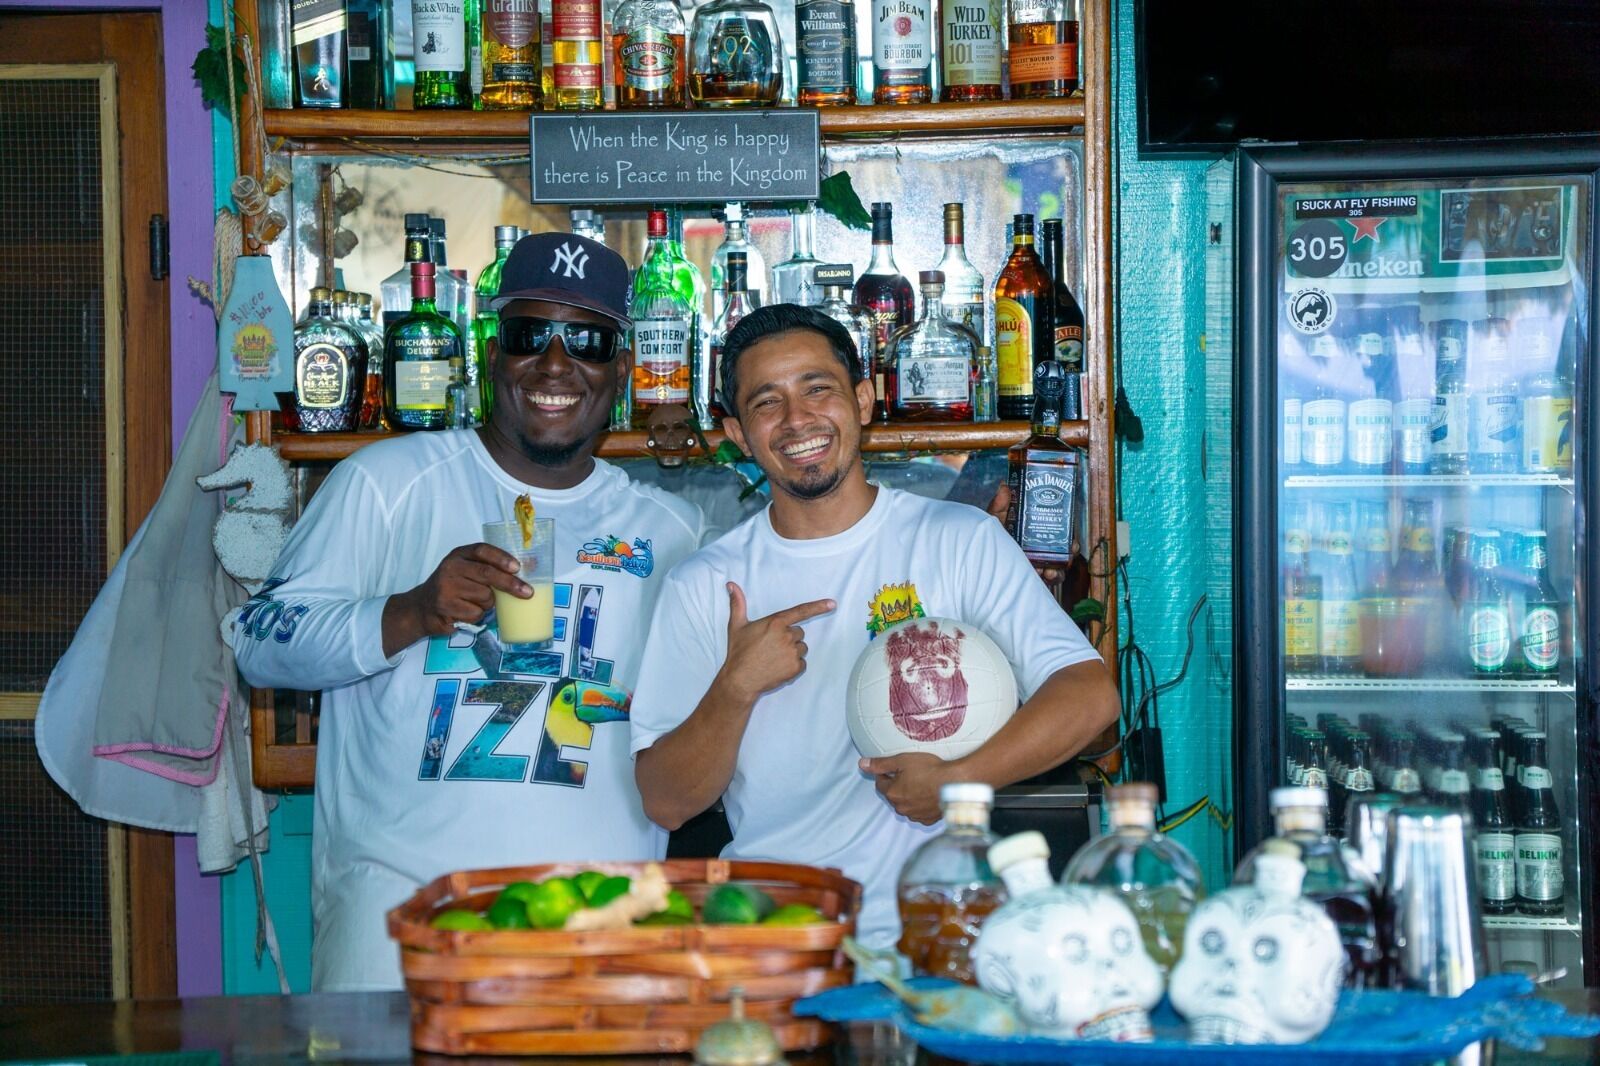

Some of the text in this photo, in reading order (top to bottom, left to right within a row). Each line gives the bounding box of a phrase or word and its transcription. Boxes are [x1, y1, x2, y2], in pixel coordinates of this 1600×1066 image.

[809, 10, 837, 20] Evan
[880, 1, 924, 22] JIM BEAM
[954, 6, 985, 23] WILD
[947, 23, 991, 40] TURKEY
[622, 44, 673, 56] CHIVAS REGAL
[884, 49, 922, 59] BOURBON
[949, 43, 974, 65] 101
[569, 121, 790, 156] When the King is happy
[544, 157, 808, 189] there is Peace in the Kingdom
[1296, 197, 1417, 211] I SUCK AT FLY FISHING
[1290, 236, 1345, 262] 305
[550, 241, 590, 280] NY
[1328, 256, 1425, 278] ineken
[1291, 287, 1326, 302] POLAR
[997, 318, 1025, 333] HLÚA
[1296, 317, 1332, 332] CAMEL
[638, 329, 685, 342] SOUTHERN
[1055, 327, 1082, 340] AILE
[395, 338, 450, 347] BUCHANAN'S
[641, 343, 683, 355] COMFORT
[407, 347, 440, 355] DELUXE
[1025, 474, 1074, 493] JACK DANIEL'S
[418, 678, 595, 788] IZE
[1519, 849, 1559, 860] BELIKIN
